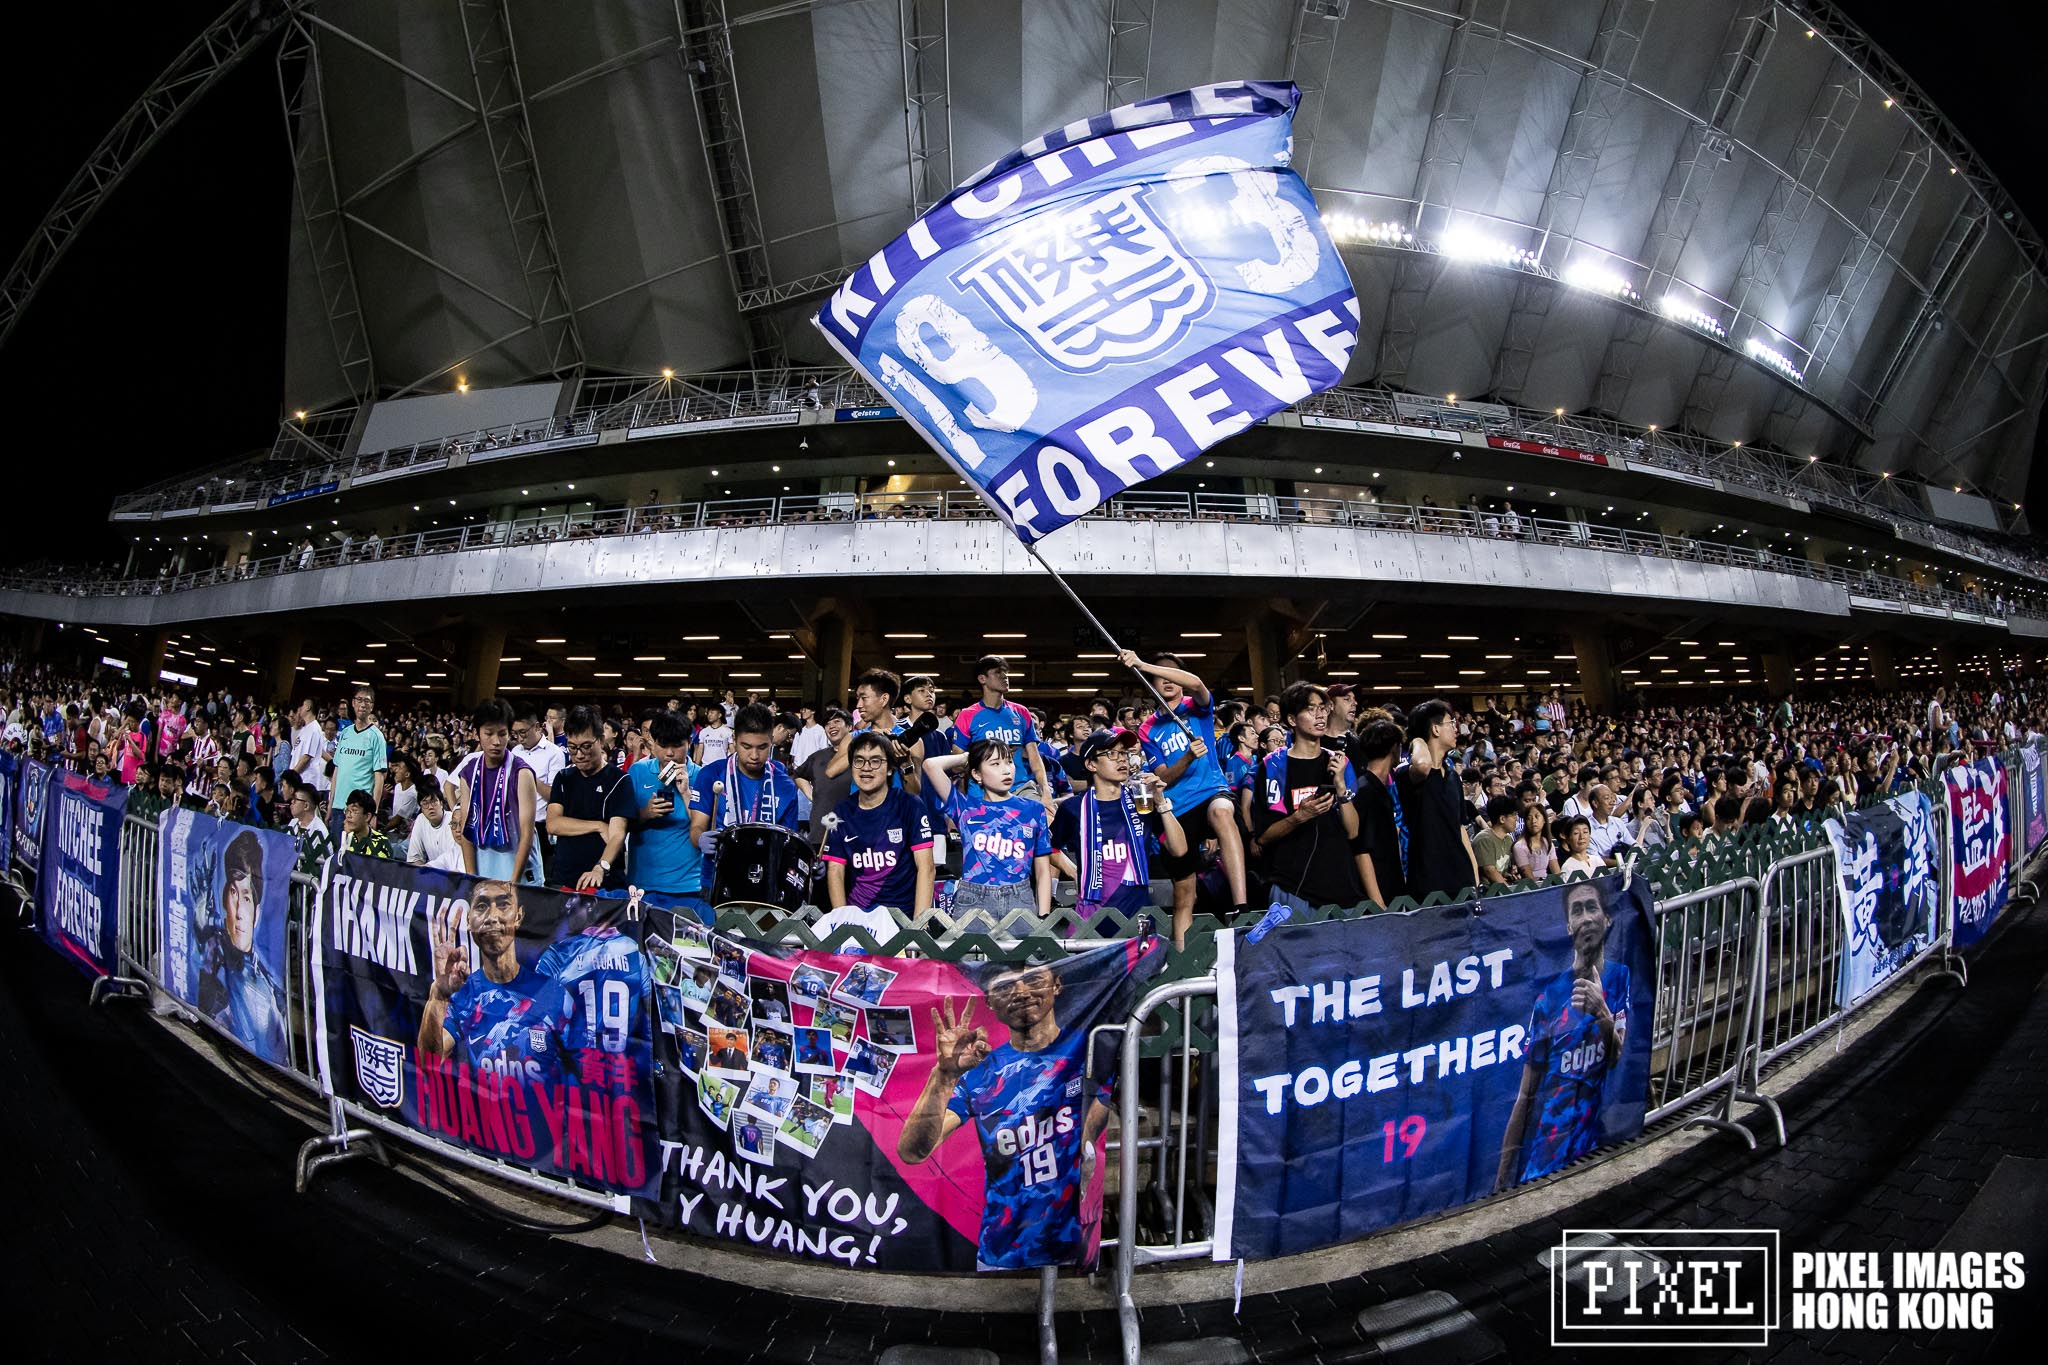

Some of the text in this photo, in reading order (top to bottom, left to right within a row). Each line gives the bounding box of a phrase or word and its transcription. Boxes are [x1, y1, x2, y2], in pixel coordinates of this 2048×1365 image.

[851, 410, 881, 419] Telstra
[995, 296, 1360, 538] FOREVE
[339, 746, 366, 757] Canon
[985, 726, 1021, 745] edps
[1161, 731, 1192, 757] edp
[58, 793, 104, 876] KITCHEE
[973, 832, 1026, 860] edps
[1130, 811, 1144, 837] KONG
[852, 848, 897, 871] edps
[1102, 839, 1127, 864] dp
[54, 865, 104, 960] FOREVER
[332, 873, 421, 976] THANK
[1270, 948, 1513, 1028] THE LAST
[578, 979, 630, 1053] 19
[1254, 1023, 1527, 1115] TOGETHER
[1560, 1037, 1605, 1075] edps
[414, 1046, 645, 1189] HUANG YANG
[996, 1105, 1075, 1156] edps
[1381, 1114, 1427, 1164] 19
[659, 1140, 908, 1234] THANK YOU,
[1019, 1142, 1058, 1187] 19
[679, 1193, 882, 1266] Y HUANG!
